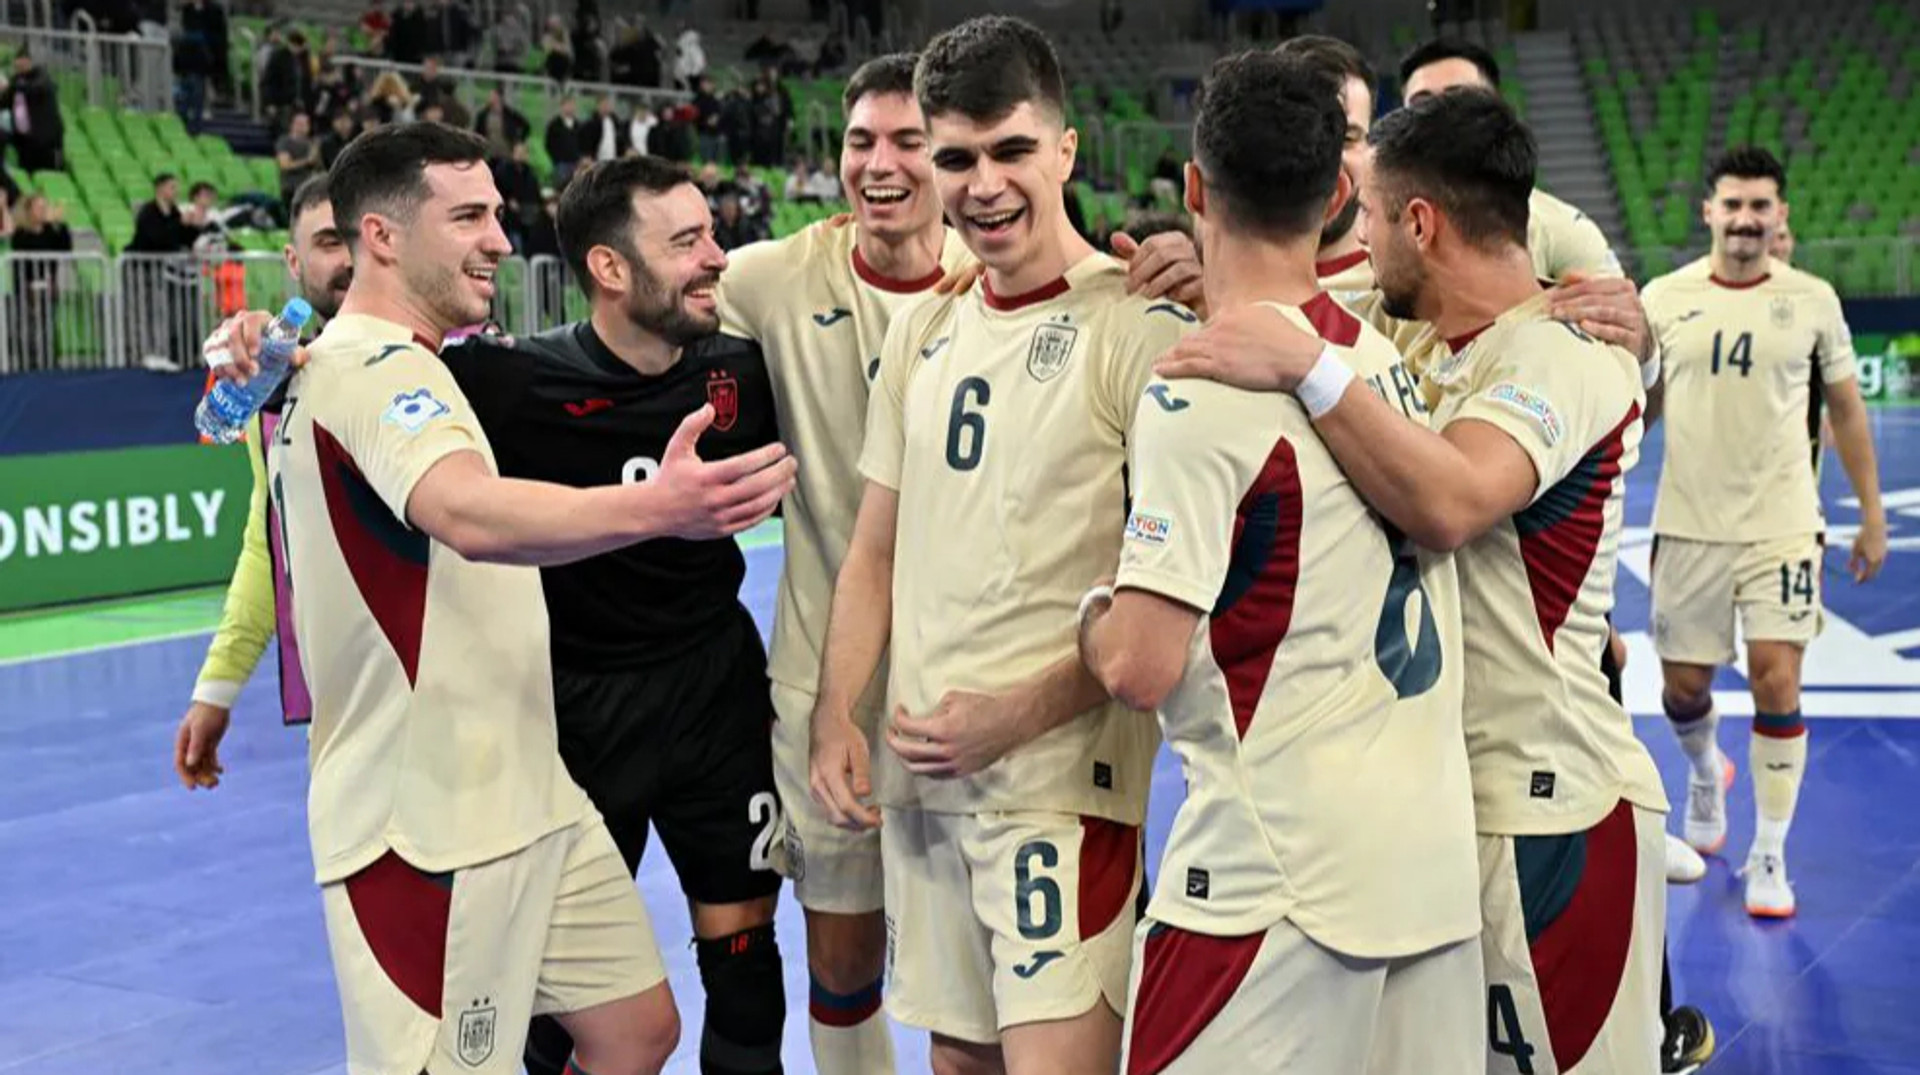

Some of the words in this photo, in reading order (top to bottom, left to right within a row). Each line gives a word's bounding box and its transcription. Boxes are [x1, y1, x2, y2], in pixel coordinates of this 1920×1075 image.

[1711, 330, 1753, 377] 14
[946, 376, 991, 471] 6
[1781, 560, 1813, 605] 14
[749, 791, 778, 870] 2
[1015, 841, 1062, 940] 6
[1489, 985, 1534, 1075] 4
